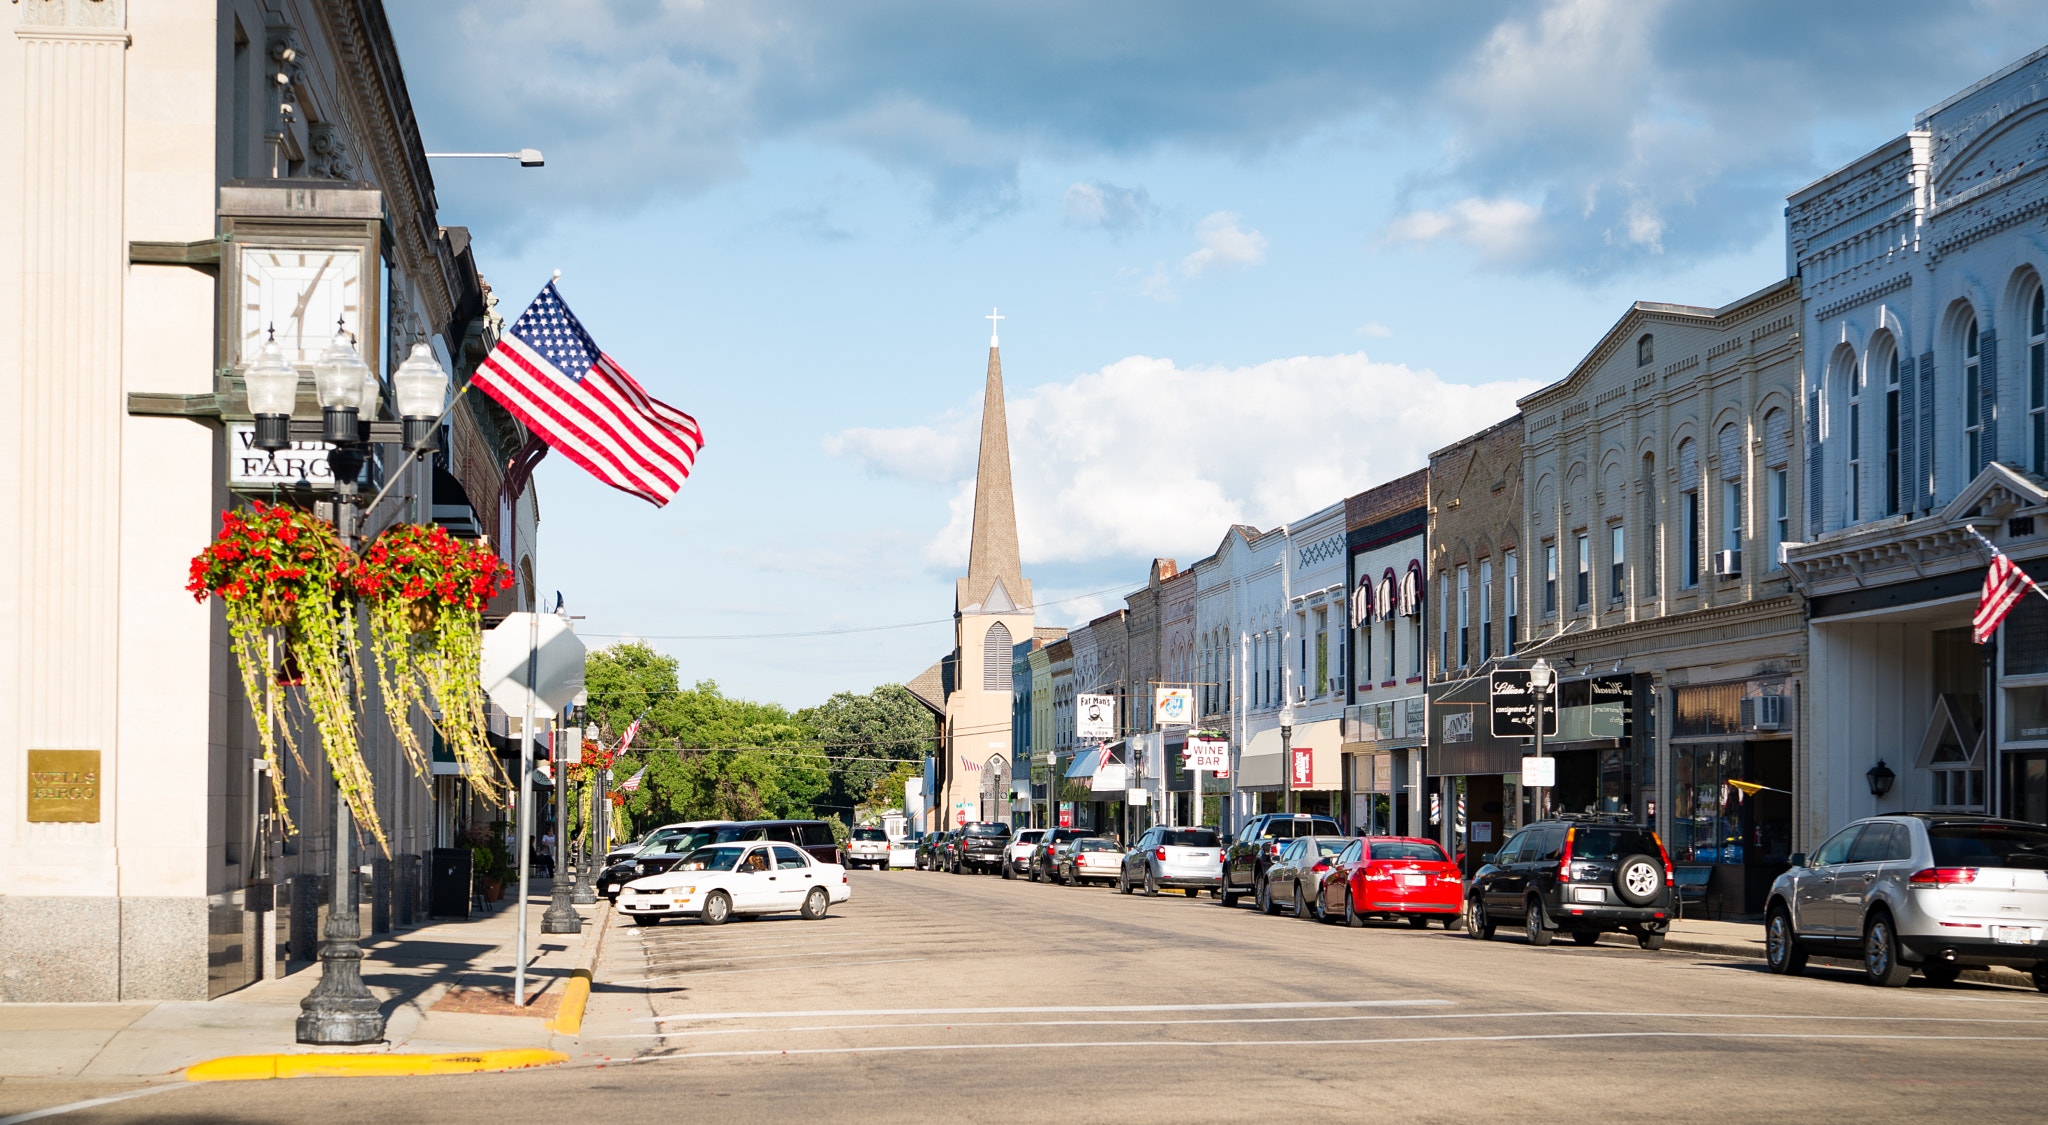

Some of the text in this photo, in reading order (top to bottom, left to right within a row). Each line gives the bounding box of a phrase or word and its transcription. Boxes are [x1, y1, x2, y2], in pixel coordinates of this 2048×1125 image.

[240, 458, 332, 477] FARG
[1080, 696, 1110, 706] Fat Man's
[1194, 746, 1224, 755] WINE
[1197, 757, 1220, 766] BAR
[32, 772, 96, 784] WELLS
[33, 787, 95, 799] FARGO
